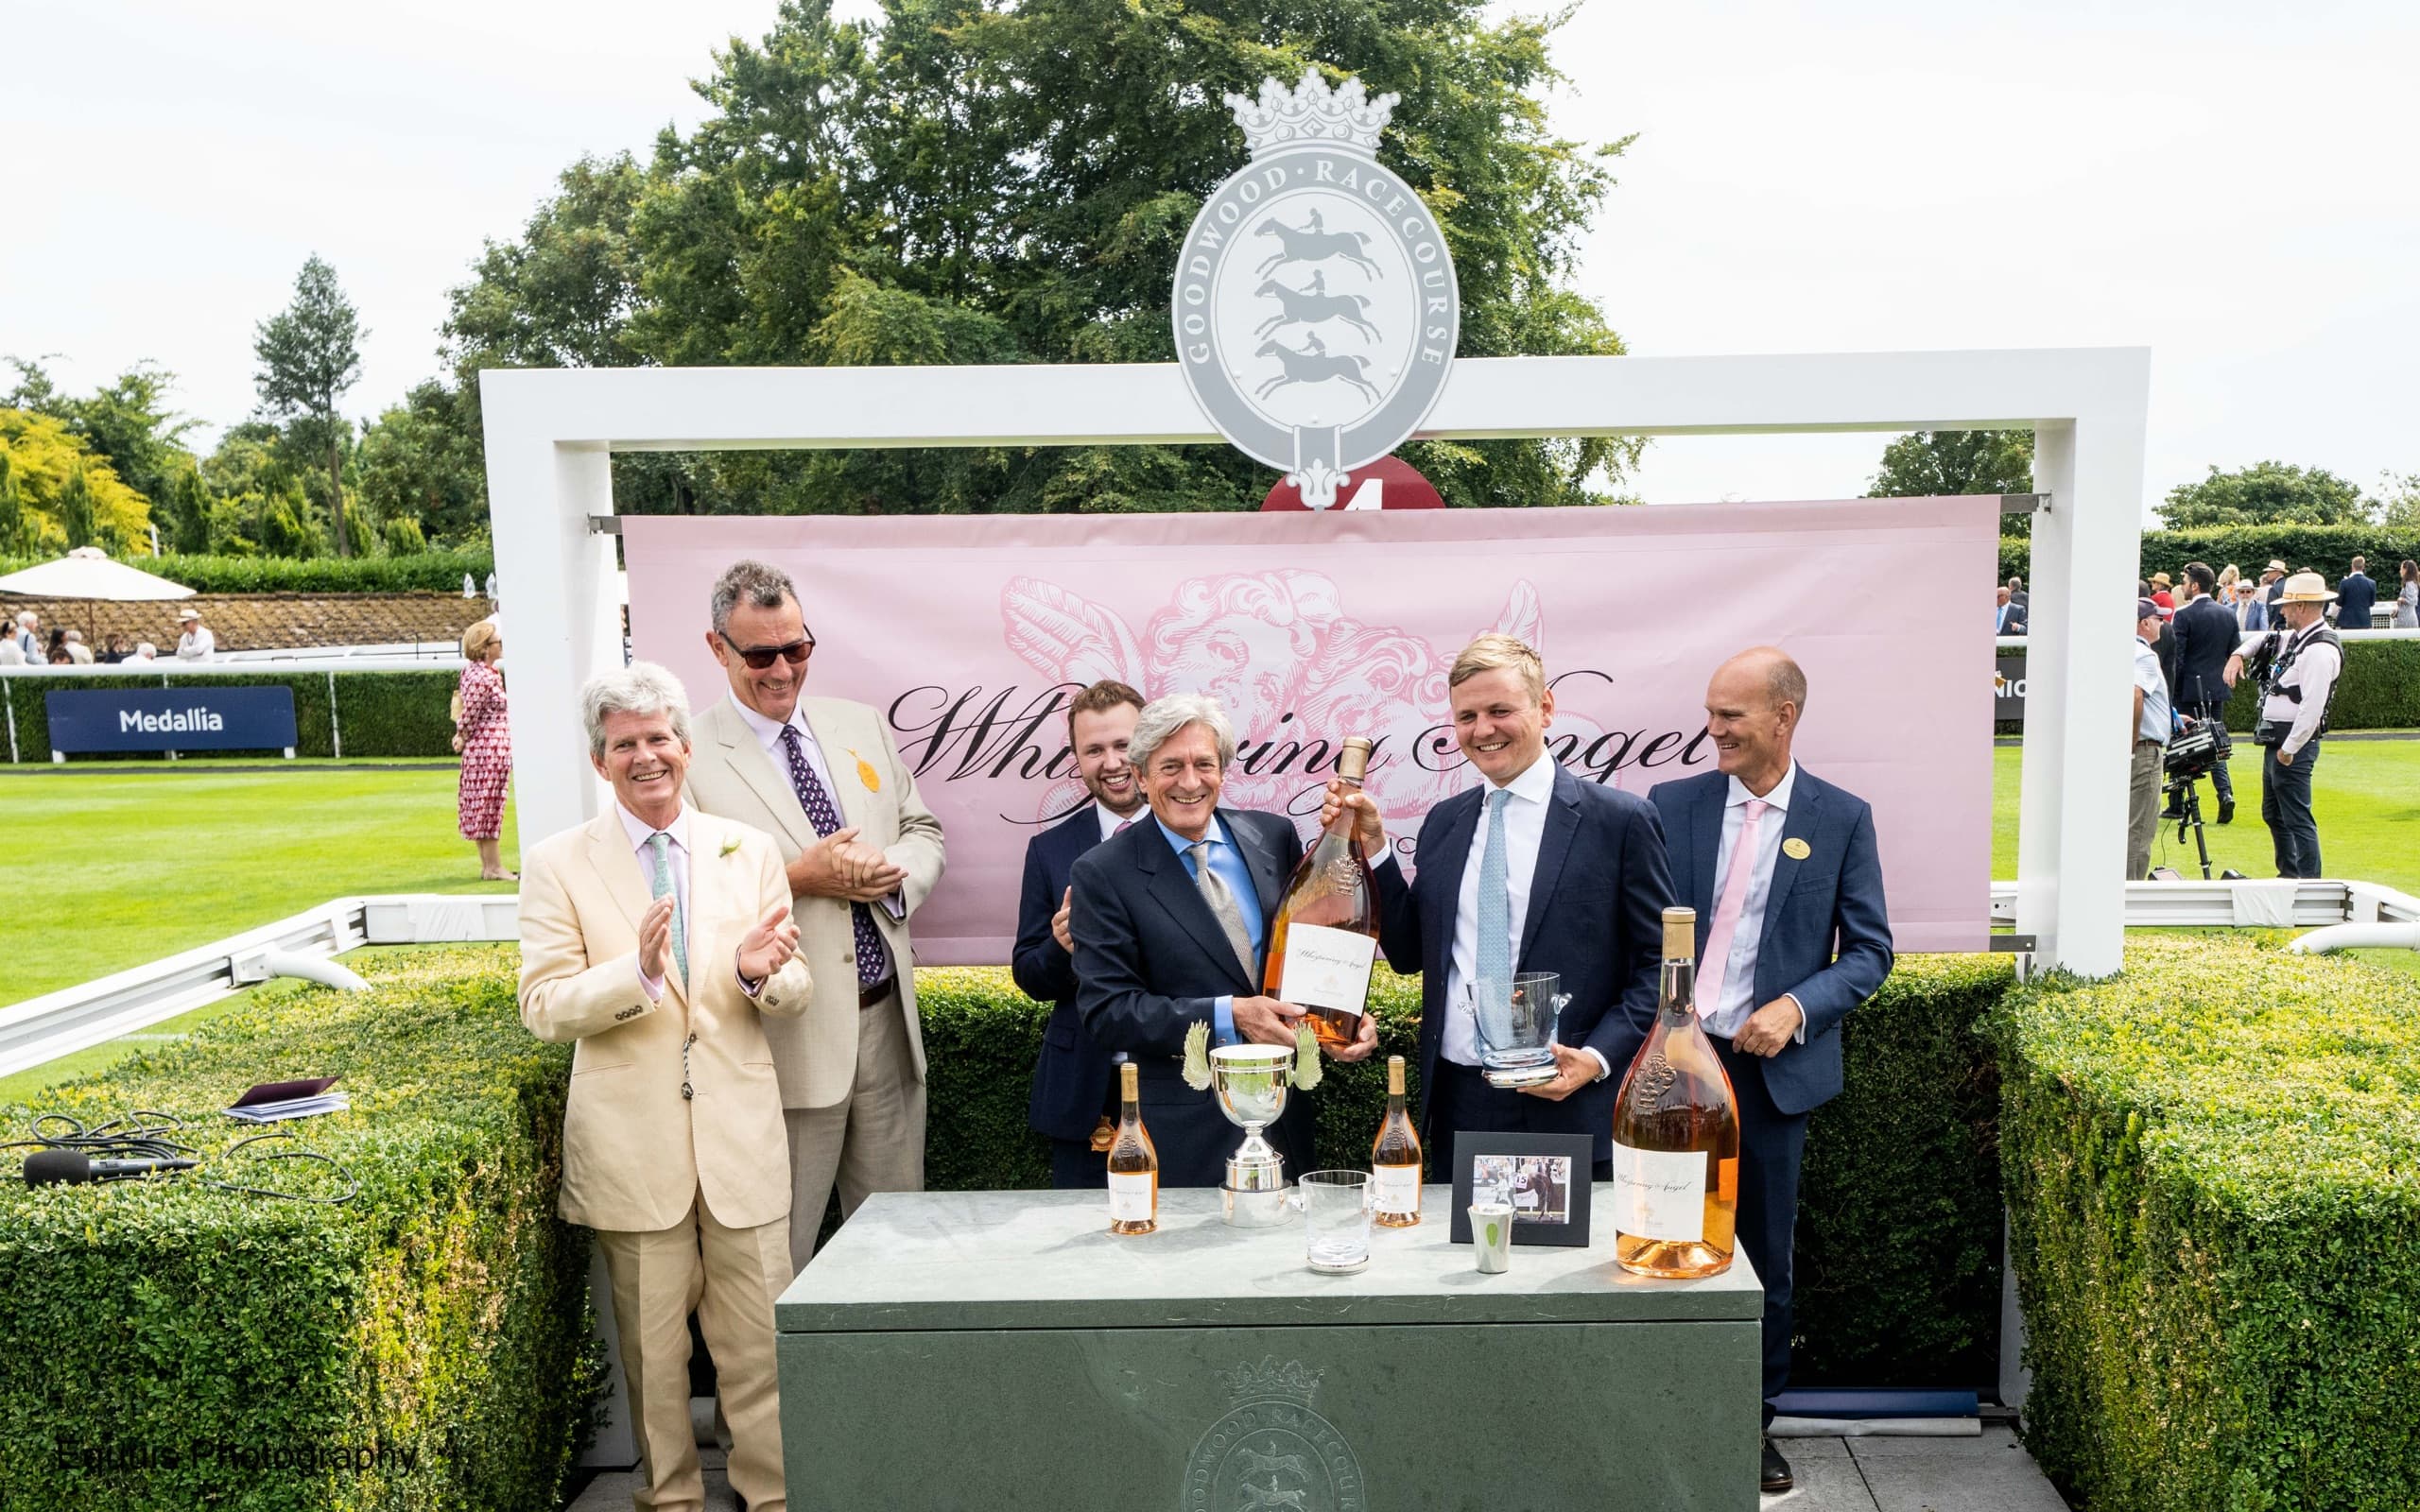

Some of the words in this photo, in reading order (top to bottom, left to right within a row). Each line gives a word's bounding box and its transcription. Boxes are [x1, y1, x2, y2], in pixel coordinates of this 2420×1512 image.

[1184, 167, 1288, 364] GOODWOOD
[1315, 160, 1448, 365] RACECOURSE
[119, 707, 223, 732] Medallia
[1516, 1176, 1527, 1184] 15
[1193, 1413, 1255, 1512] ODWOOD
[1271, 1408, 1356, 1512] RACECOUR
